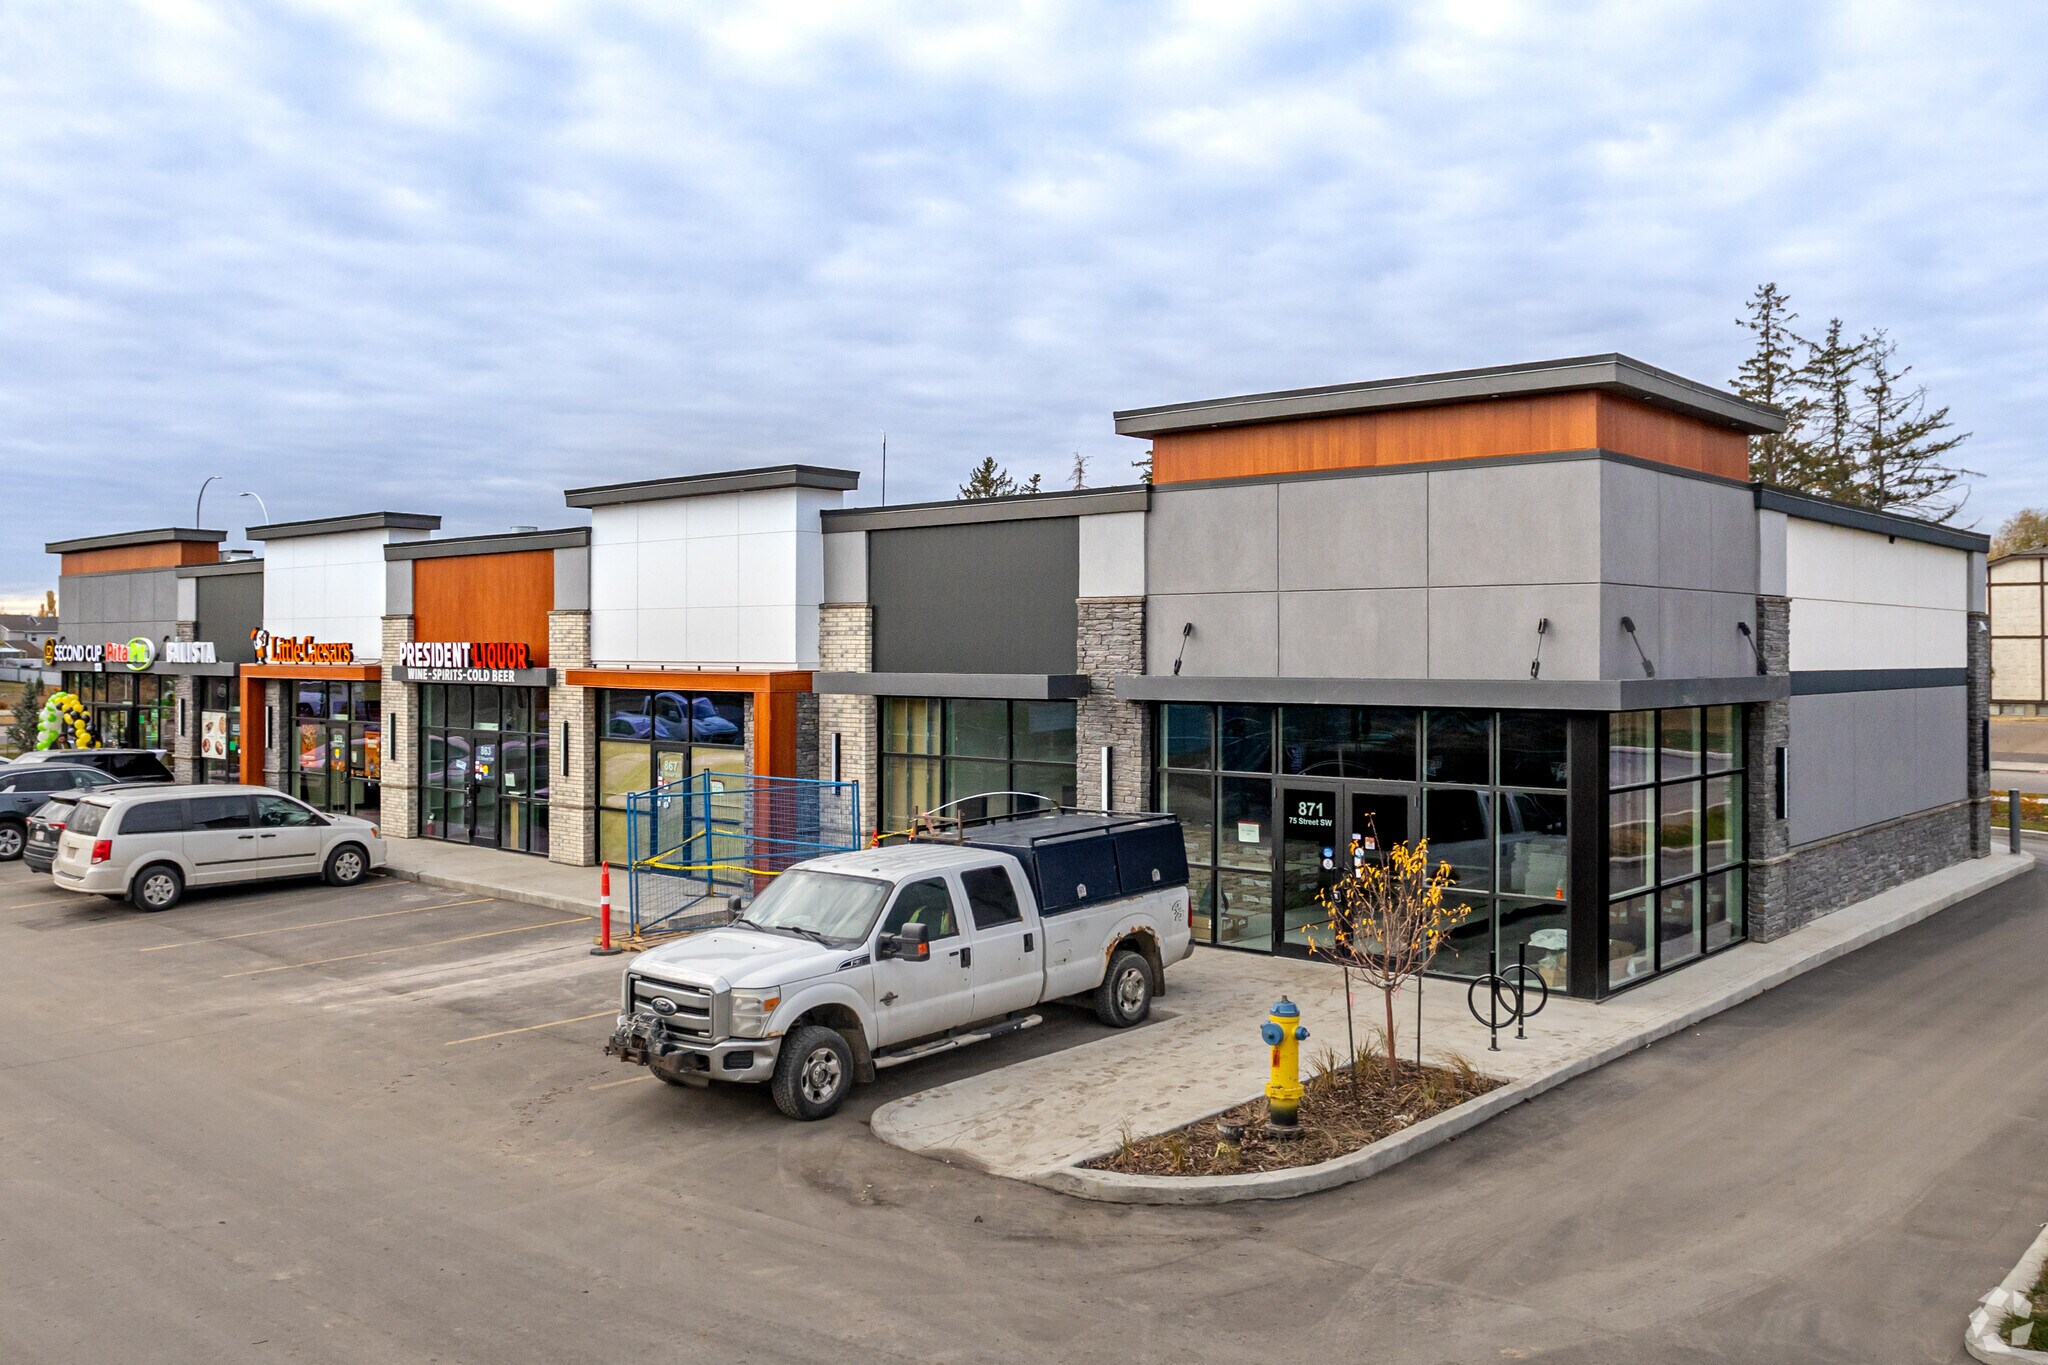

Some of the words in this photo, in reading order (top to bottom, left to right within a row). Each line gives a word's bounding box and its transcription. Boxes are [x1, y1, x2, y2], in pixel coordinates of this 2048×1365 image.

[54, 644, 84, 662] SECOND
[85, 644, 102, 662] CUP
[105, 642, 128, 662] Pita
[270, 636, 300, 662] Little
[302, 636, 353, 662] Caesars
[399, 642, 471, 667] PRESIDENT
[472, 642, 528, 669] LIQUOR
[491, 669, 515, 682] BEER
[663, 761, 678, 771] 867
[1298, 801, 1323, 817] 871
[1289, 816, 1297, 825] 75
[1298, 817, 1319, 826] Street
[1320, 818, 1333, 827] SW
